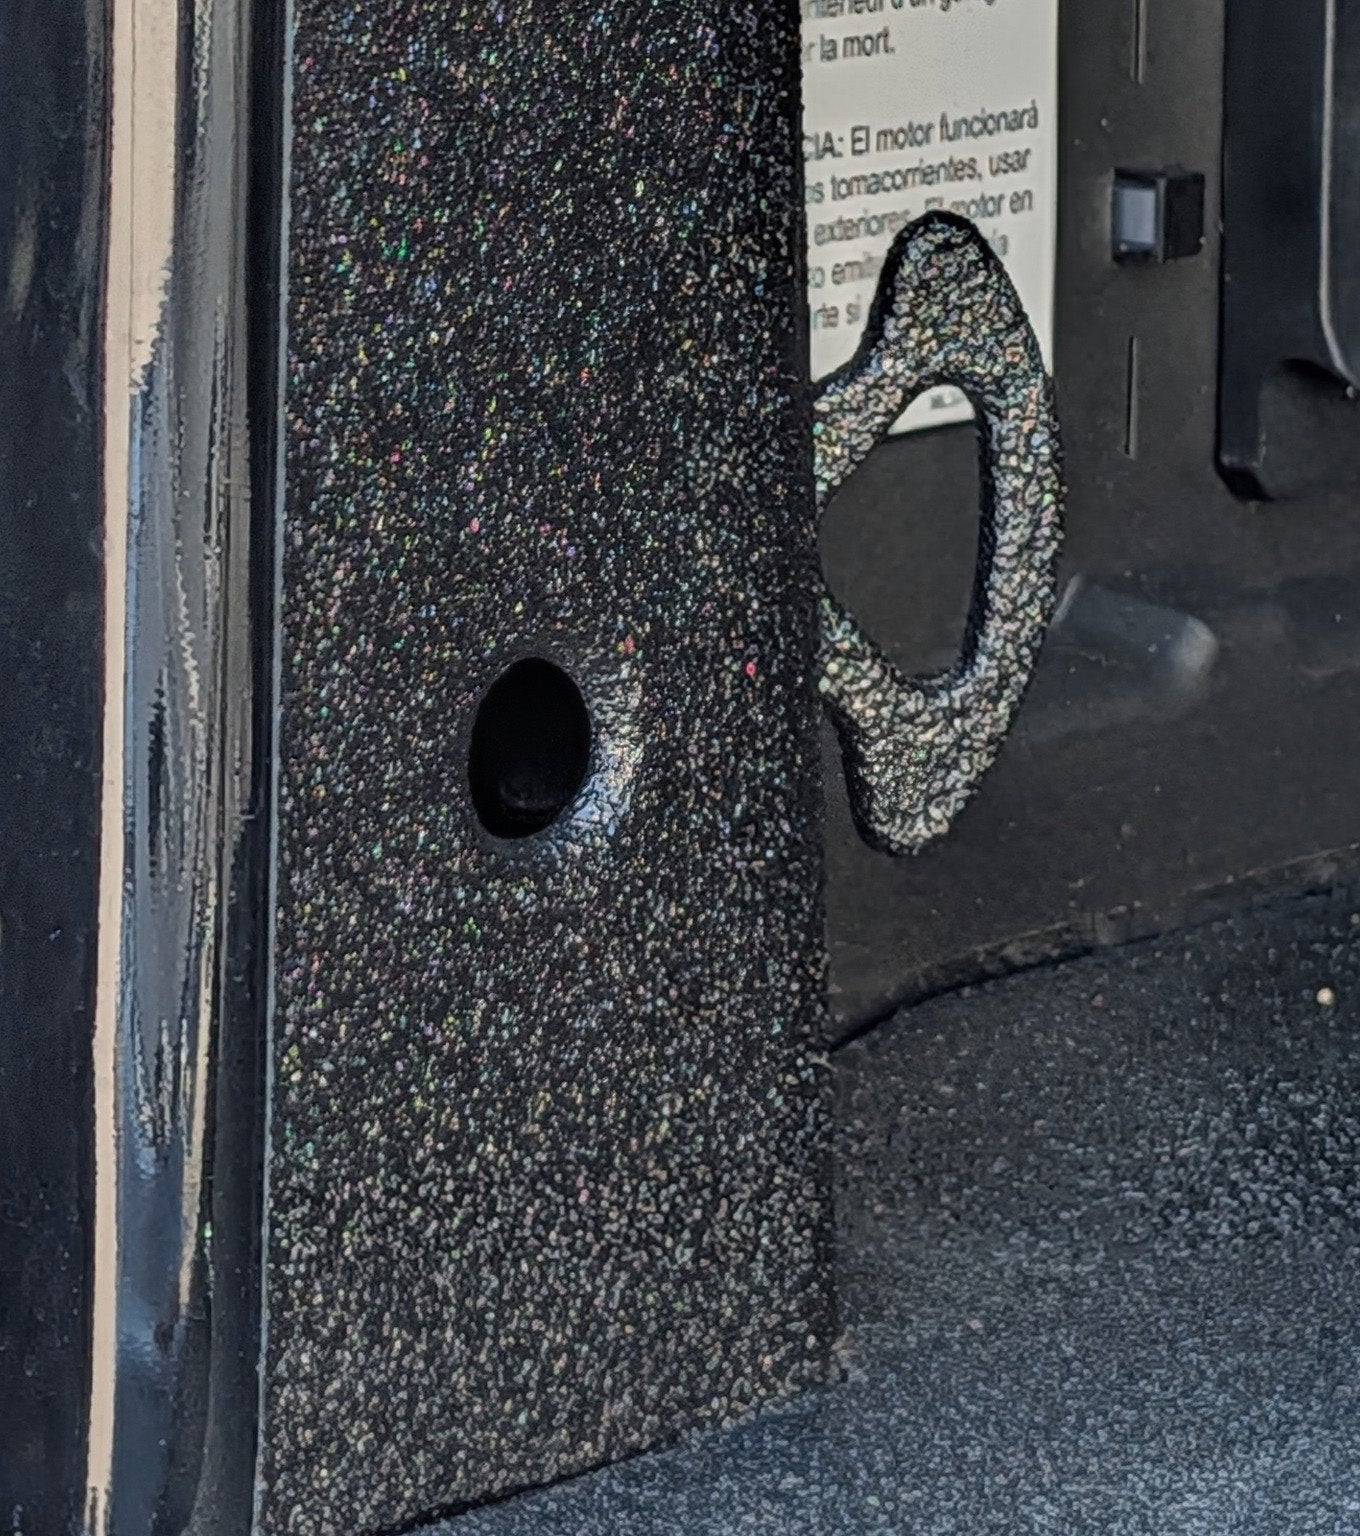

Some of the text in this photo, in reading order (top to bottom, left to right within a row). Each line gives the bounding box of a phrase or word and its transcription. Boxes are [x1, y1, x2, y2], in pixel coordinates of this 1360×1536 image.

[820, 34, 838, 62] la
[842, 26, 895, 57] mort.
[851, 125, 870, 156] El
[876, 121, 934, 152] motor
[939, 99, 1038, 143] funcionará
[831, 154, 982, 201] tomacorrientes,
[989, 148, 1031, 178] usar
[1009, 189, 1033, 214] en
